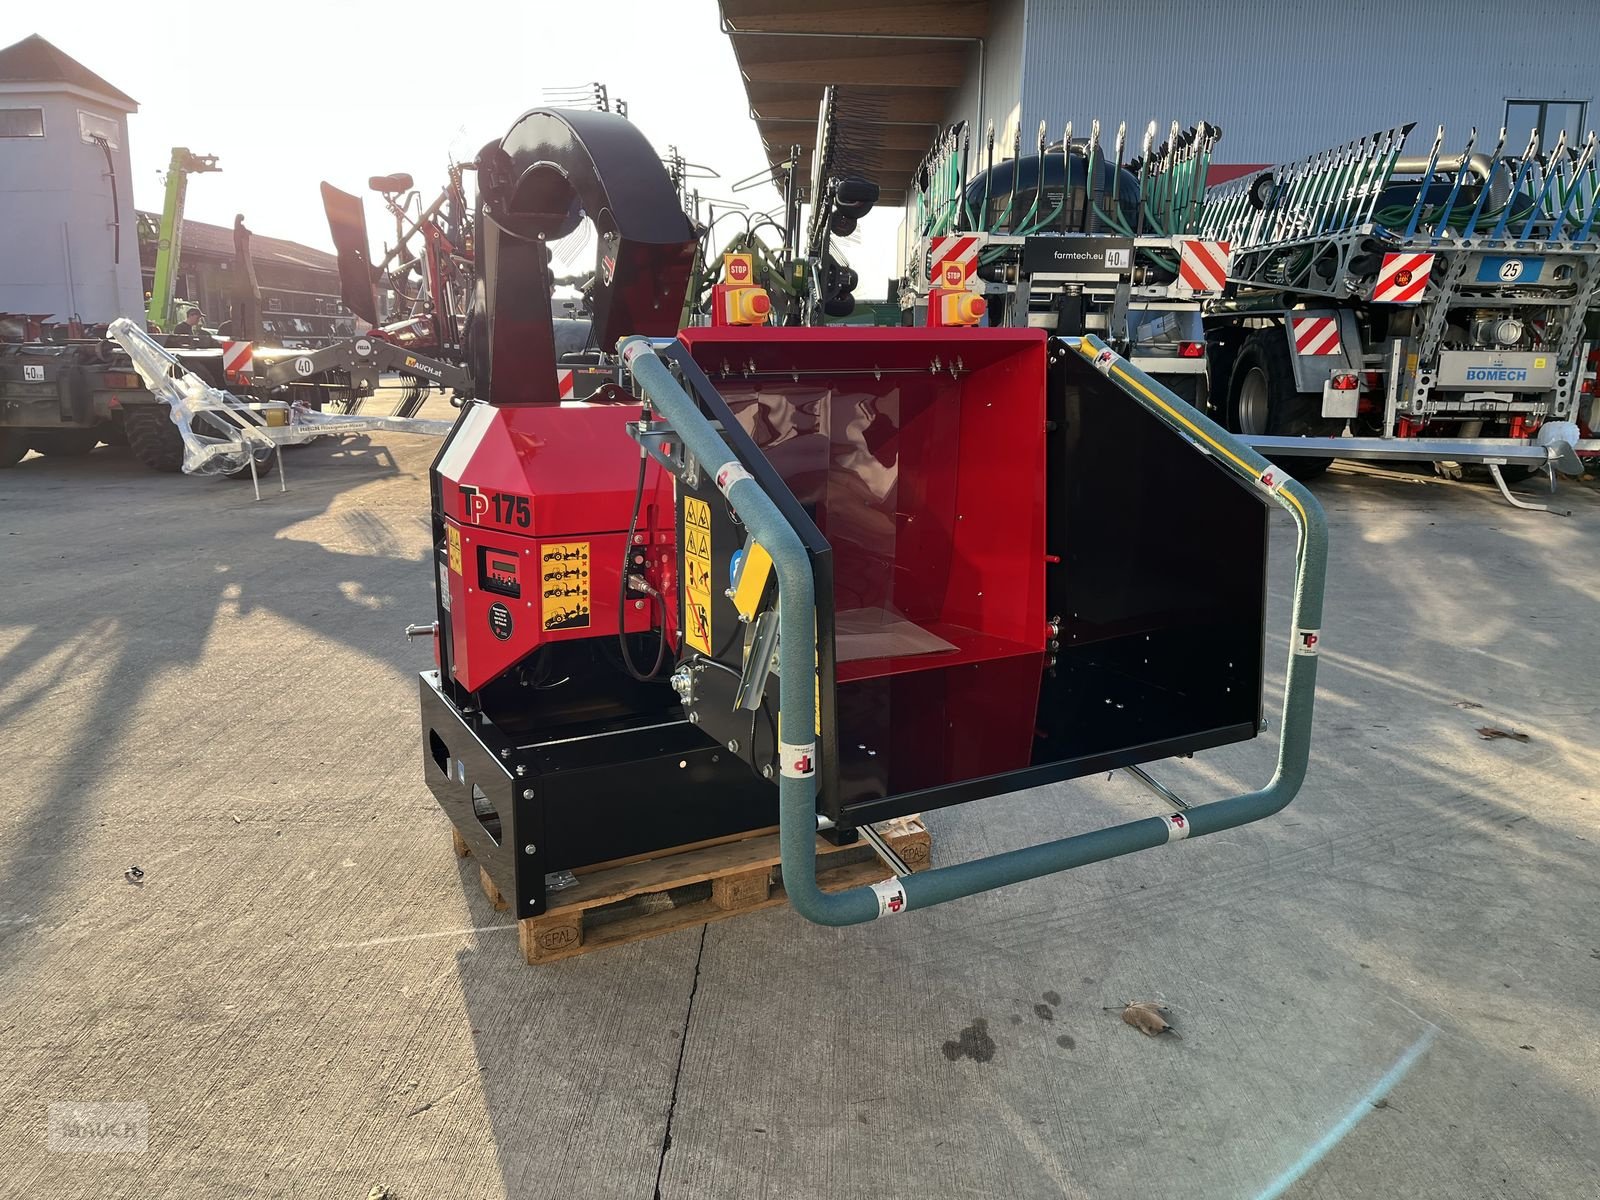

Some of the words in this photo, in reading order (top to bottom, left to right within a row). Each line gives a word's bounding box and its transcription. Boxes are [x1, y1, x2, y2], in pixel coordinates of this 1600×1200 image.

[1054, 251, 1104, 260] farmtech.eu
[1107, 252, 1120, 266] 40
[731, 265, 747, 274] STOP
[947, 271, 961, 280] STOP
[1503, 263, 1520, 277] 25
[26, 367, 36, 379] 40
[298, 361, 311, 374] 40
[407, 356, 442, 377] MAUCH.at
[1467, 370, 1527, 381] BOMECH
[459, 484, 489, 525] TP
[492, 493, 531, 528] 175
[1300, 632, 1318, 648] TP
[794, 755, 814, 774] TP
[888, 890, 903, 912] TP
[544, 930, 573, 947] EPAL
